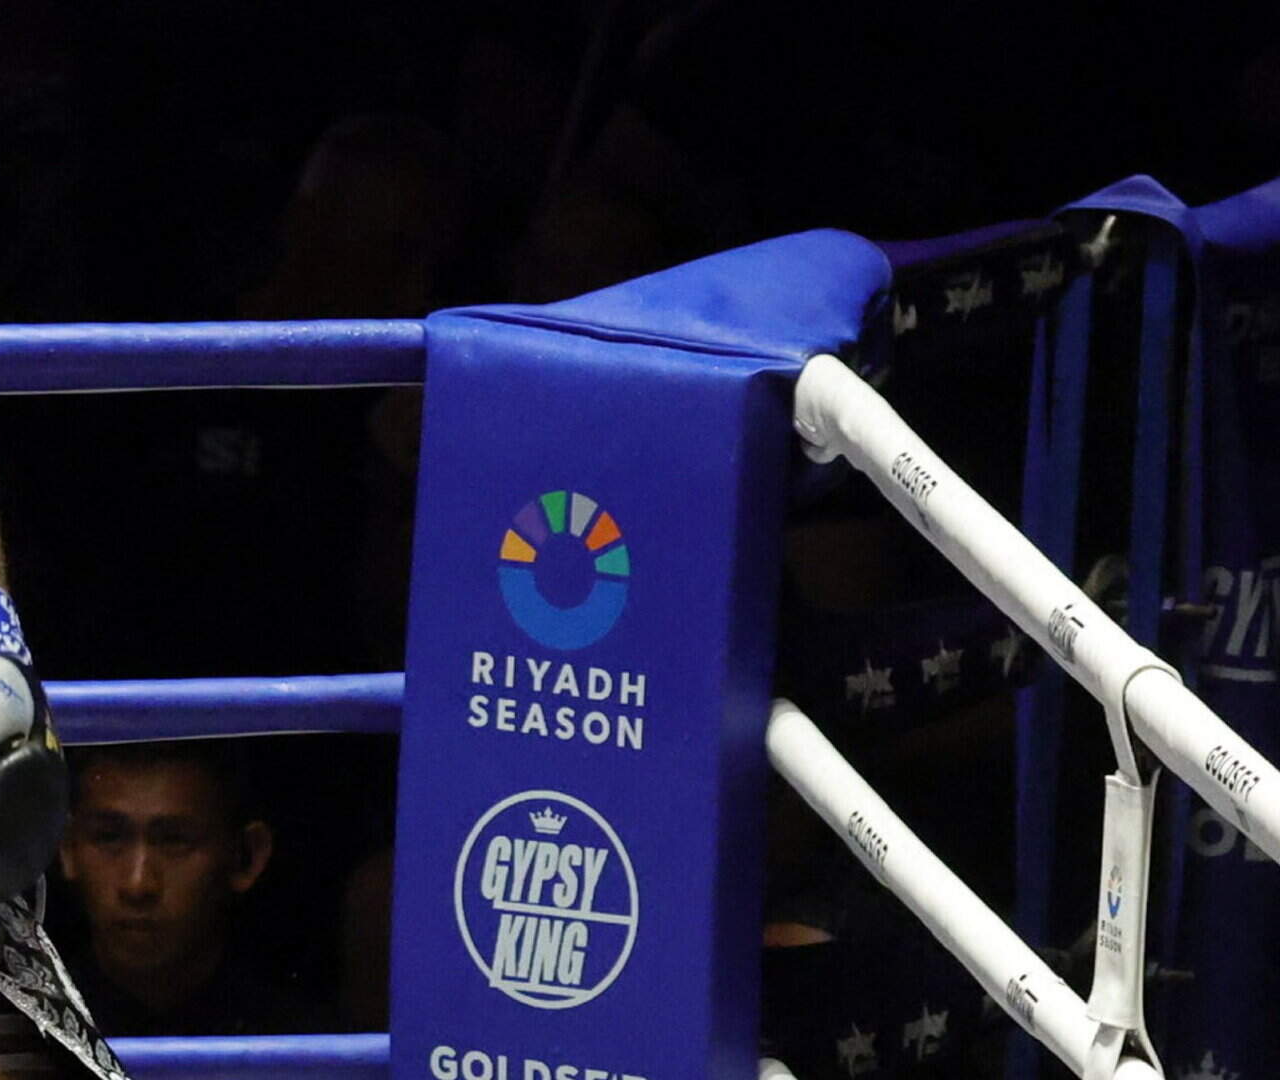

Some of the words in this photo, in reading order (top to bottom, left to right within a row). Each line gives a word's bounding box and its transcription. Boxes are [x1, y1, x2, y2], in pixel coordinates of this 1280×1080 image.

[472, 652, 646, 706] RIYADH
[468, 696, 644, 750] SEASON
[481, 835, 608, 913] GYPSY
[493, 914, 589, 986] KING
